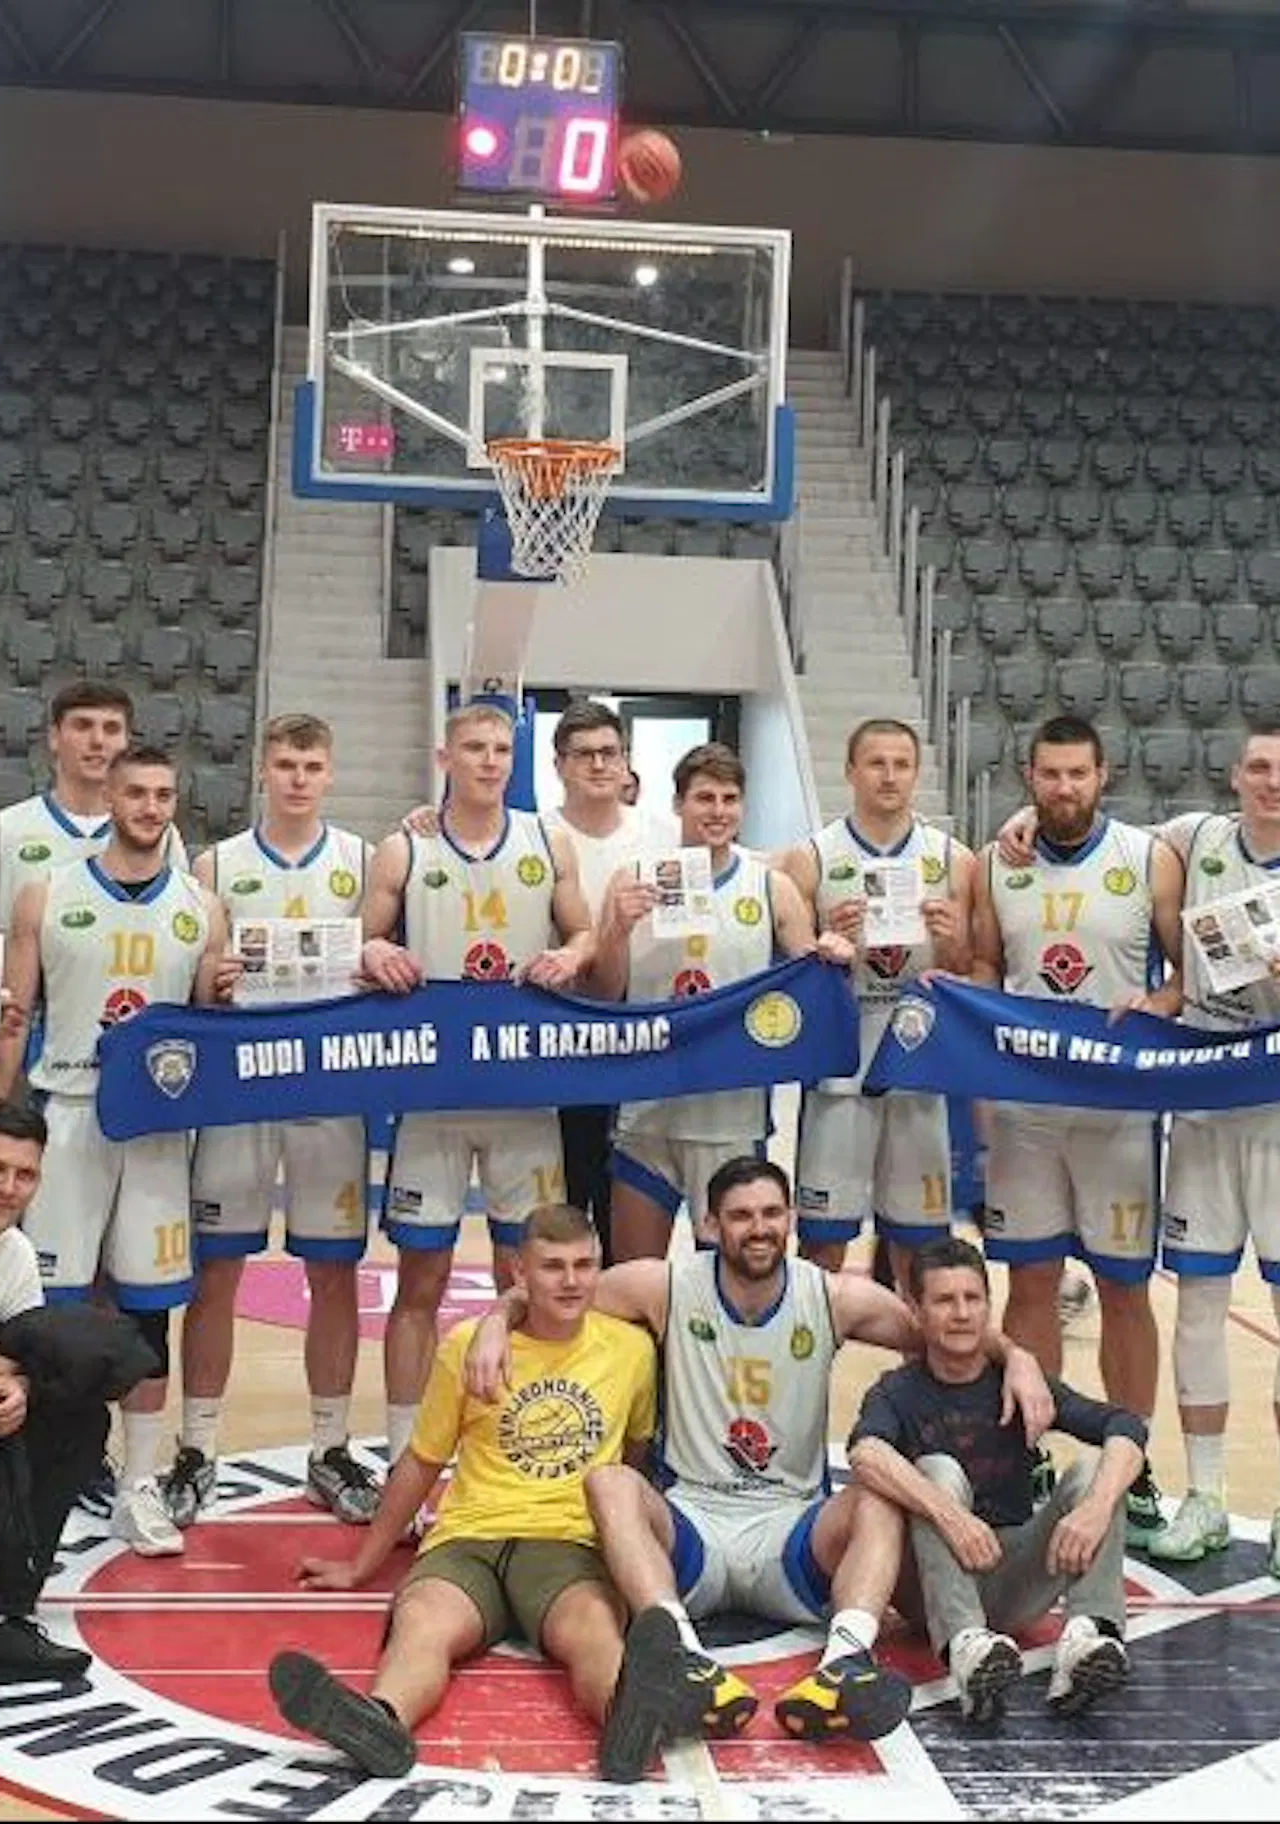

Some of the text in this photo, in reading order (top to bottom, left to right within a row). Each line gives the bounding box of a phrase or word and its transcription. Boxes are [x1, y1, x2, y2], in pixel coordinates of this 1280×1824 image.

[462, 892, 509, 932] 14
[1041, 892, 1081, 931] 17
[105, 932, 156, 978] 10
[236, 1016, 670, 1078] BUDI NAVIJAČ A NE RAZBIJAČ
[1068, 1034, 1122, 1064] NE!
[334, 1180, 359, 1220] 4
[1112, 1202, 1145, 1242] 17
